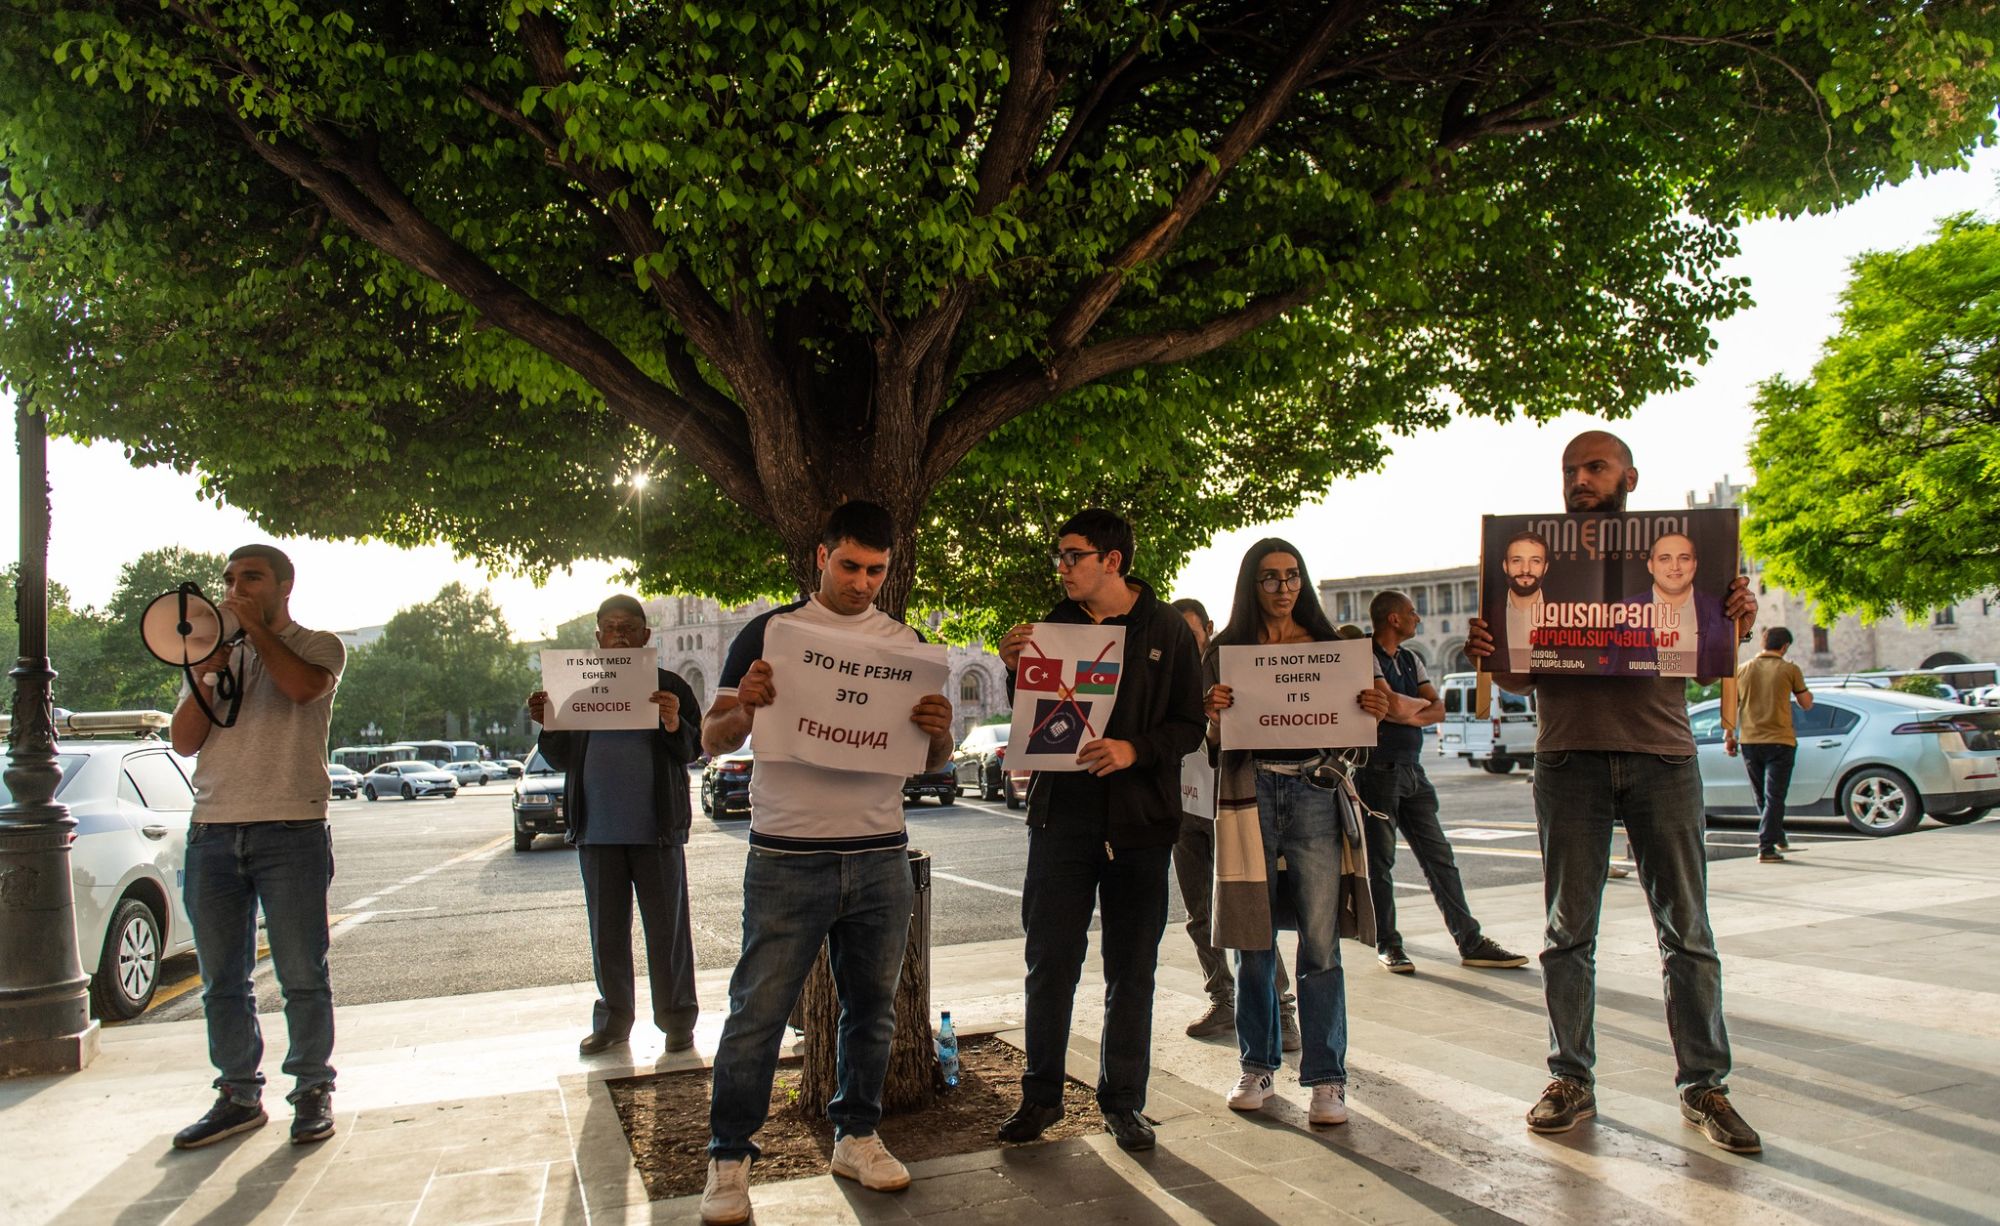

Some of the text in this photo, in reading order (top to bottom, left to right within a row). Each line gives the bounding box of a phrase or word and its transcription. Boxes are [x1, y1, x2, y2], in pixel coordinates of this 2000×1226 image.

[1530, 602, 1681, 629] ԱԶԱՏՈՒԹՅՈՒՆ
[1529, 629, 1680, 648] ՔԱՂԲԱՆՏԱՐԿՅԱԼՆԵՐ
[566, 658, 574, 666] IT
[576, 658, 584, 666] IS
[606, 657, 631, 665] MEDZ
[803, 650, 912, 682] ЭТО НЕ РЕЗНЯ
[1255, 653, 1341, 667] IT IS NOT MEDZ
[582, 671, 617, 679] EGHERN
[1275, 672, 1321, 684] EGHERN
[591, 686, 599, 694] IT
[835, 688, 868, 705] ЭТО
[1287, 692, 1310, 703] IT IS
[572, 701, 631, 713] GENOCIDE
[1259, 712, 1339, 727] GENOCIDE
[798, 717, 889, 750] ГЕНОЦИД
